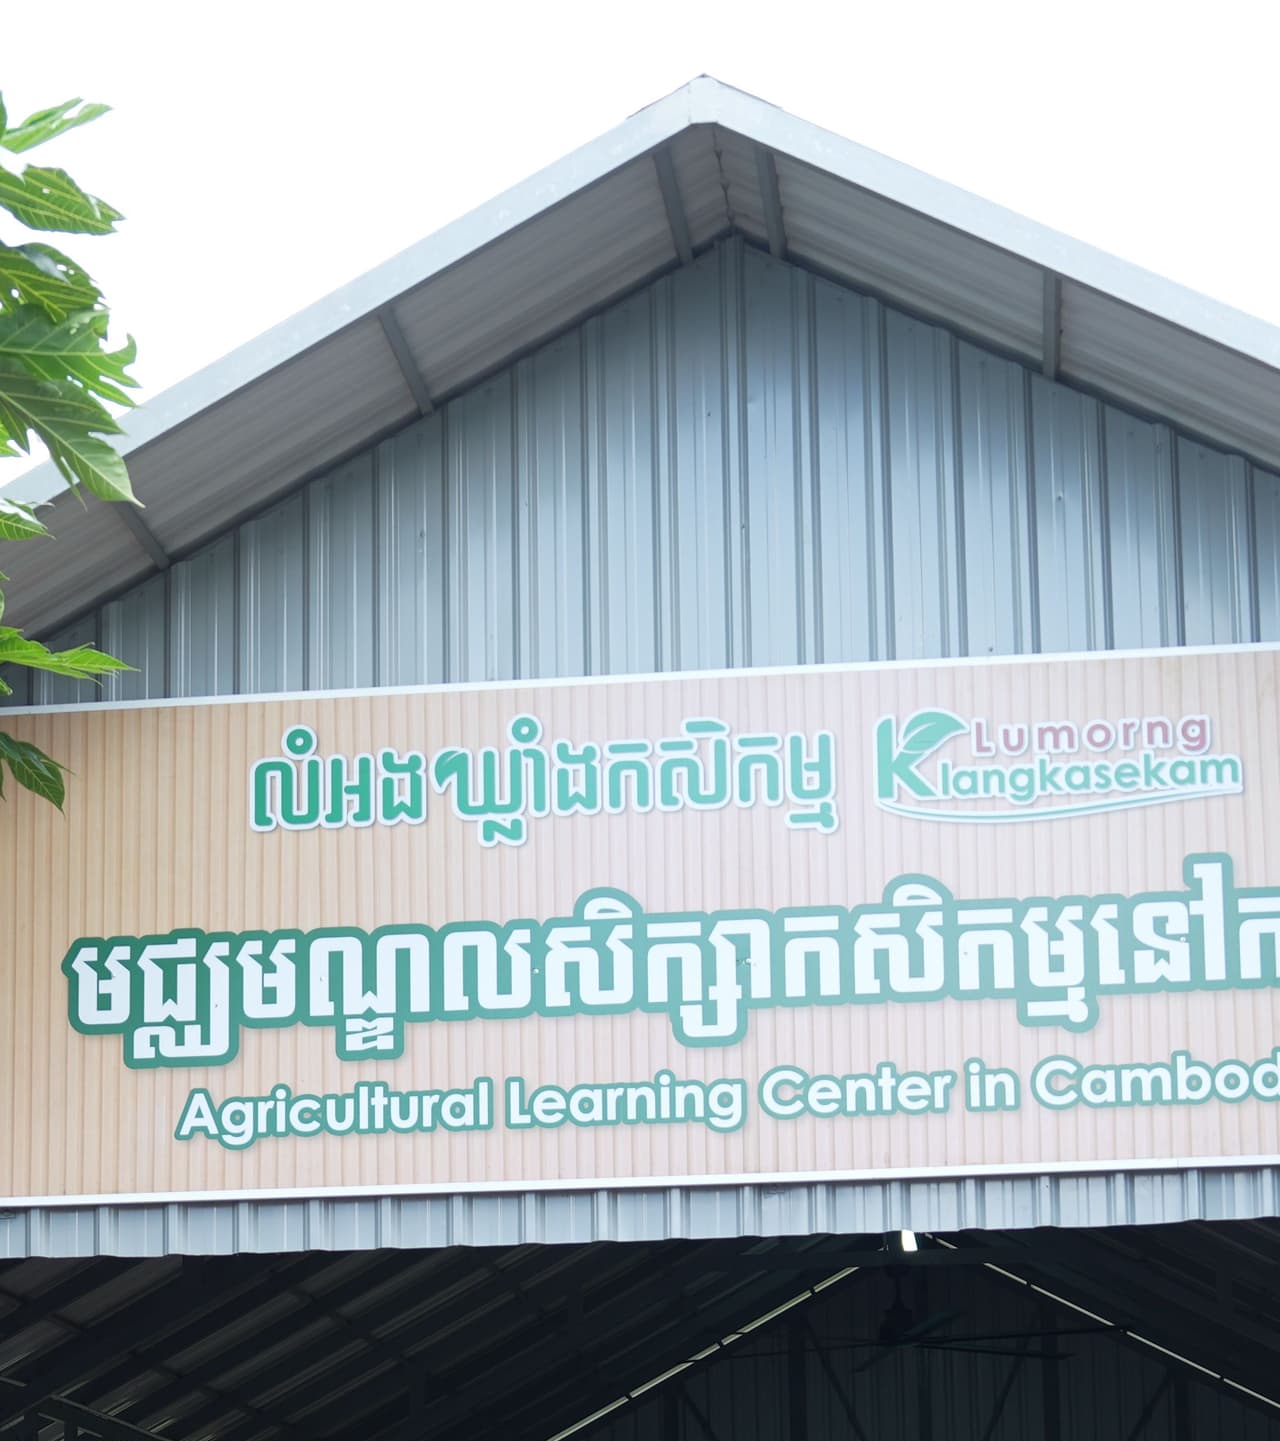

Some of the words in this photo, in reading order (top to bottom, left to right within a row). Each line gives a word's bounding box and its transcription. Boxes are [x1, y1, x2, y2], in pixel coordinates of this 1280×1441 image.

[877, 710, 1241, 803] Klangkasekam
[972, 713, 1211, 756] Lumorng
[179, 1080, 491, 1147] Agricultural
[507, 1073, 742, 1132] Learning
[761, 1064, 953, 1119] Center
[968, 1061, 1017, 1110] in
